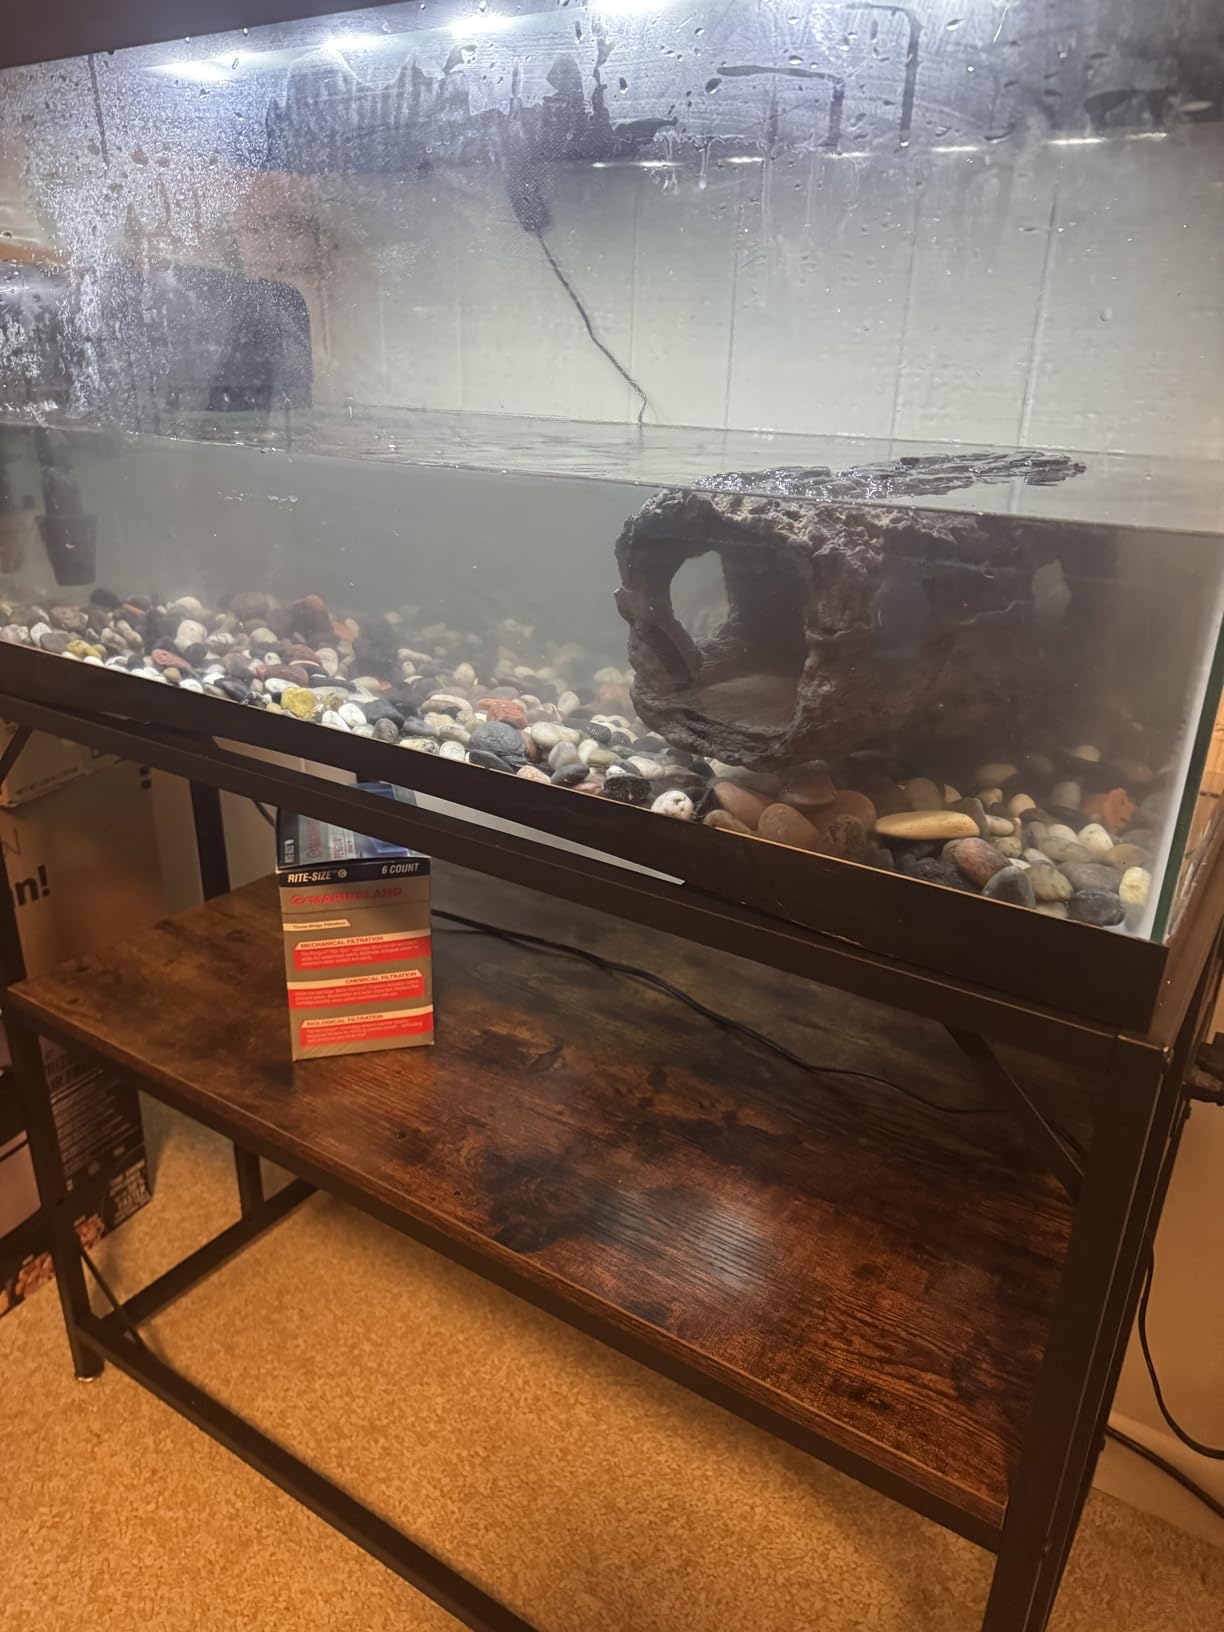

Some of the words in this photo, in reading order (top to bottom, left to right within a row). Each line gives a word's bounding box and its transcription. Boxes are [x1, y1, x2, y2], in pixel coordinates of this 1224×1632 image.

[381, 866, 388, 875] 6
[389, 862, 420, 875] COUNT
[287, 871, 332, 883] RITE-SIZE
[300, 939, 346, 948] MECHANICAL
[346, 936, 384, 944] FILTRATION
[345, 976, 378, 984] CHEMICAL
[380, 972, 417, 981] FILTRATION
[306, 1018, 347, 1026] BIOLOGICAL
[347, 1014, 384, 1022] FILTRATION
